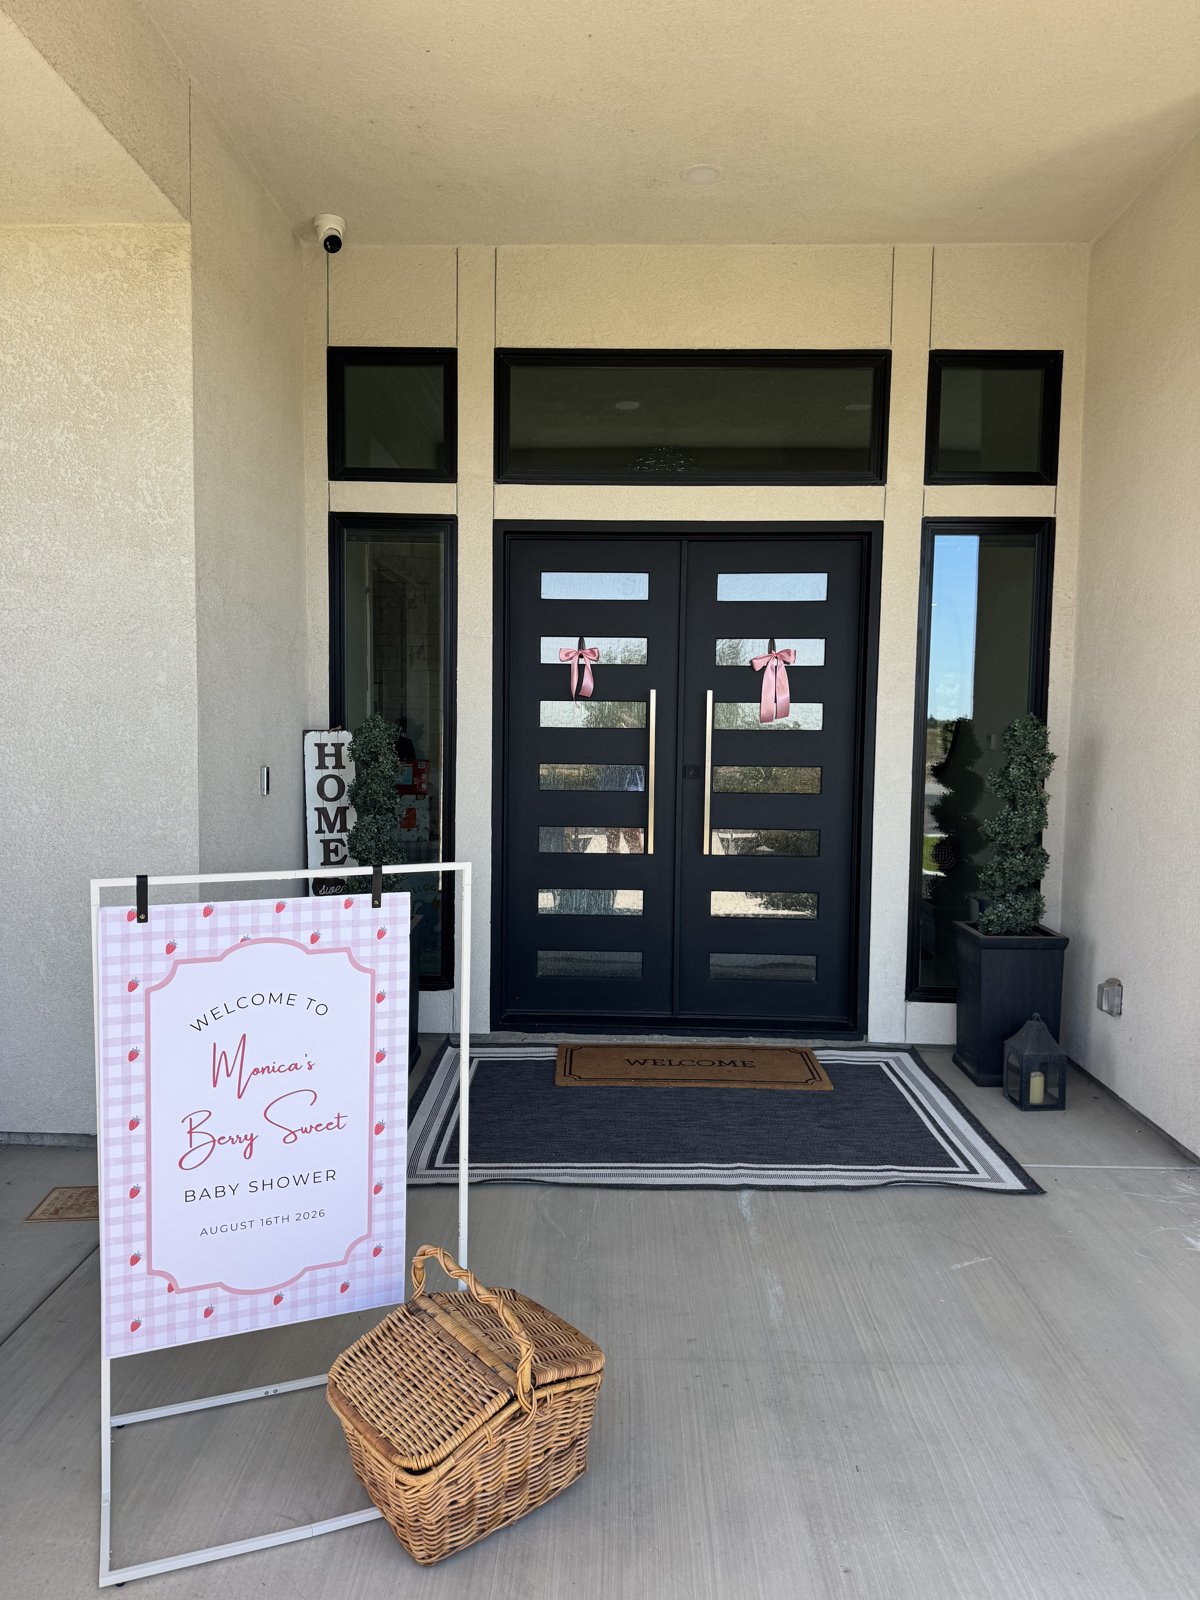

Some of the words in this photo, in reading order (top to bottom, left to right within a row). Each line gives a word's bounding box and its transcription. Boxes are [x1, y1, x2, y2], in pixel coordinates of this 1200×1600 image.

[314, 743, 349, 866] HOME
[189, 992, 298, 1032] WELCOME
[306, 996, 329, 1017] TO
[212, 1034, 316, 1099] Monica's
[625, 1058, 755, 1068] WELCOME
[178, 1109, 259, 1171] Berry
[263, 1089, 348, 1144] Sweet
[184, 1182, 241, 1203] BABY
[248, 1168, 337, 1195] SHOWER
[199, 1219, 255, 1237] AUGUST
[259, 1213, 291, 1228] 16TH
[295, 1208, 326, 1222] 2026
